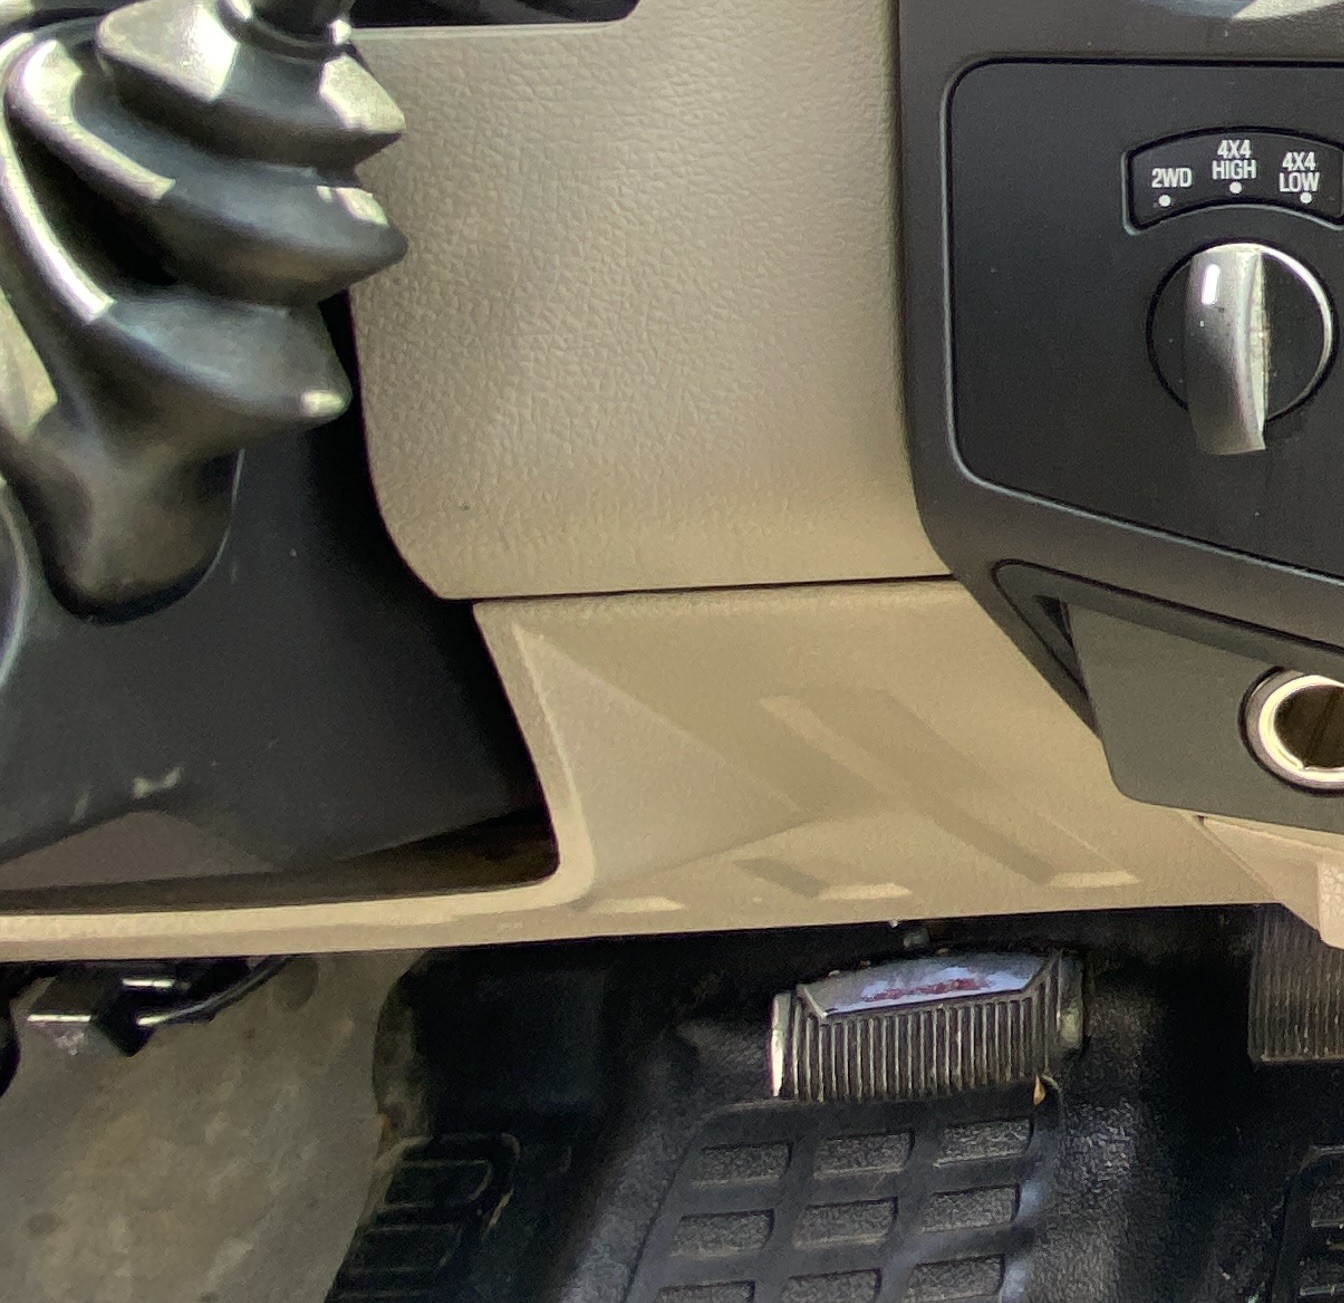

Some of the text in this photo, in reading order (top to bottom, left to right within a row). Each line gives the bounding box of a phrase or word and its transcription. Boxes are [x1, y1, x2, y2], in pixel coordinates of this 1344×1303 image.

[1151, 167, 1193, 189] 2WD
[1211, 159, 1257, 180] HIGH
[1279, 171, 1320, 193] LOW
